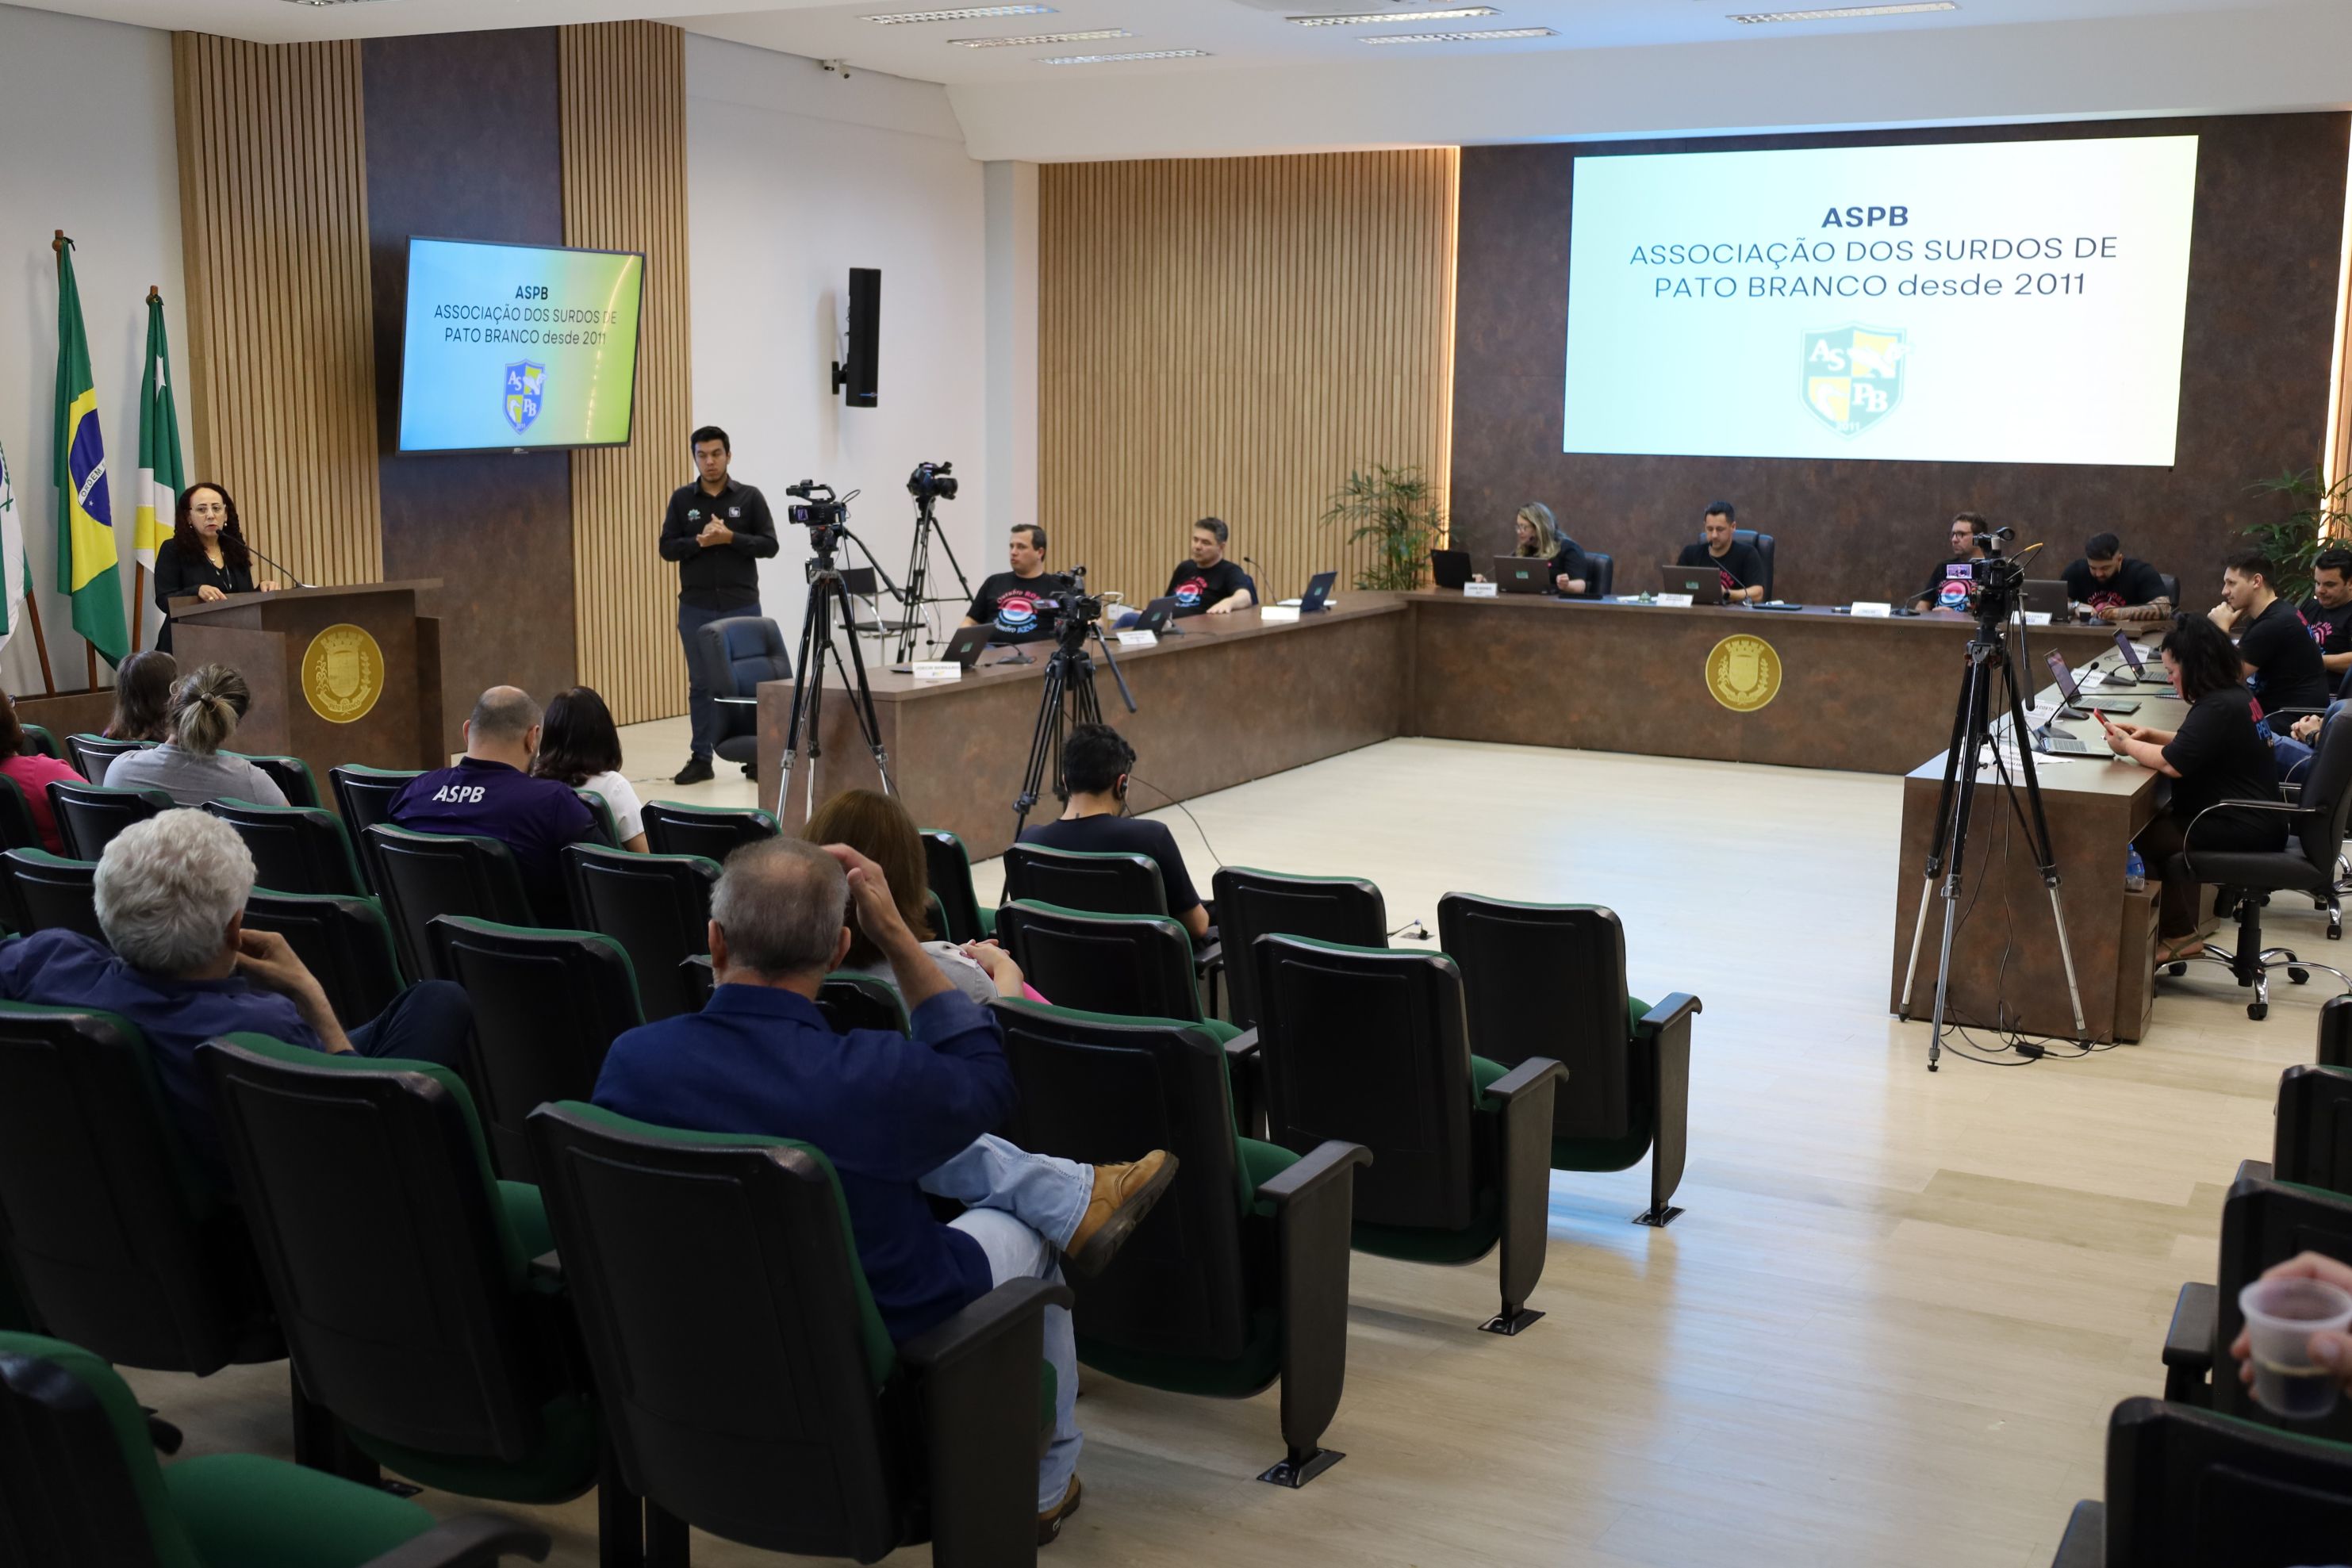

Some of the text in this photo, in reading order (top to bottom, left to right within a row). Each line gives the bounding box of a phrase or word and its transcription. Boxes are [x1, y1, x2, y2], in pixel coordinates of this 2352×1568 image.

[1821, 205, 1909, 229] ASPB
[1629, 236, 2117, 270] ASSOCIAÇÃO DOS SURDOS DE
[515, 286, 549, 301] ASPB
[1654, 272, 2086, 298] PATO BRANCO desde 2011
[435, 304, 617, 324] ASSOCIAÇÃO DOS SURDOS DE
[444, 327, 607, 346] PATO BRANCO desde 2011
[81, 468, 102, 497] ORDEM
[432, 786, 485, 803] ASPB
